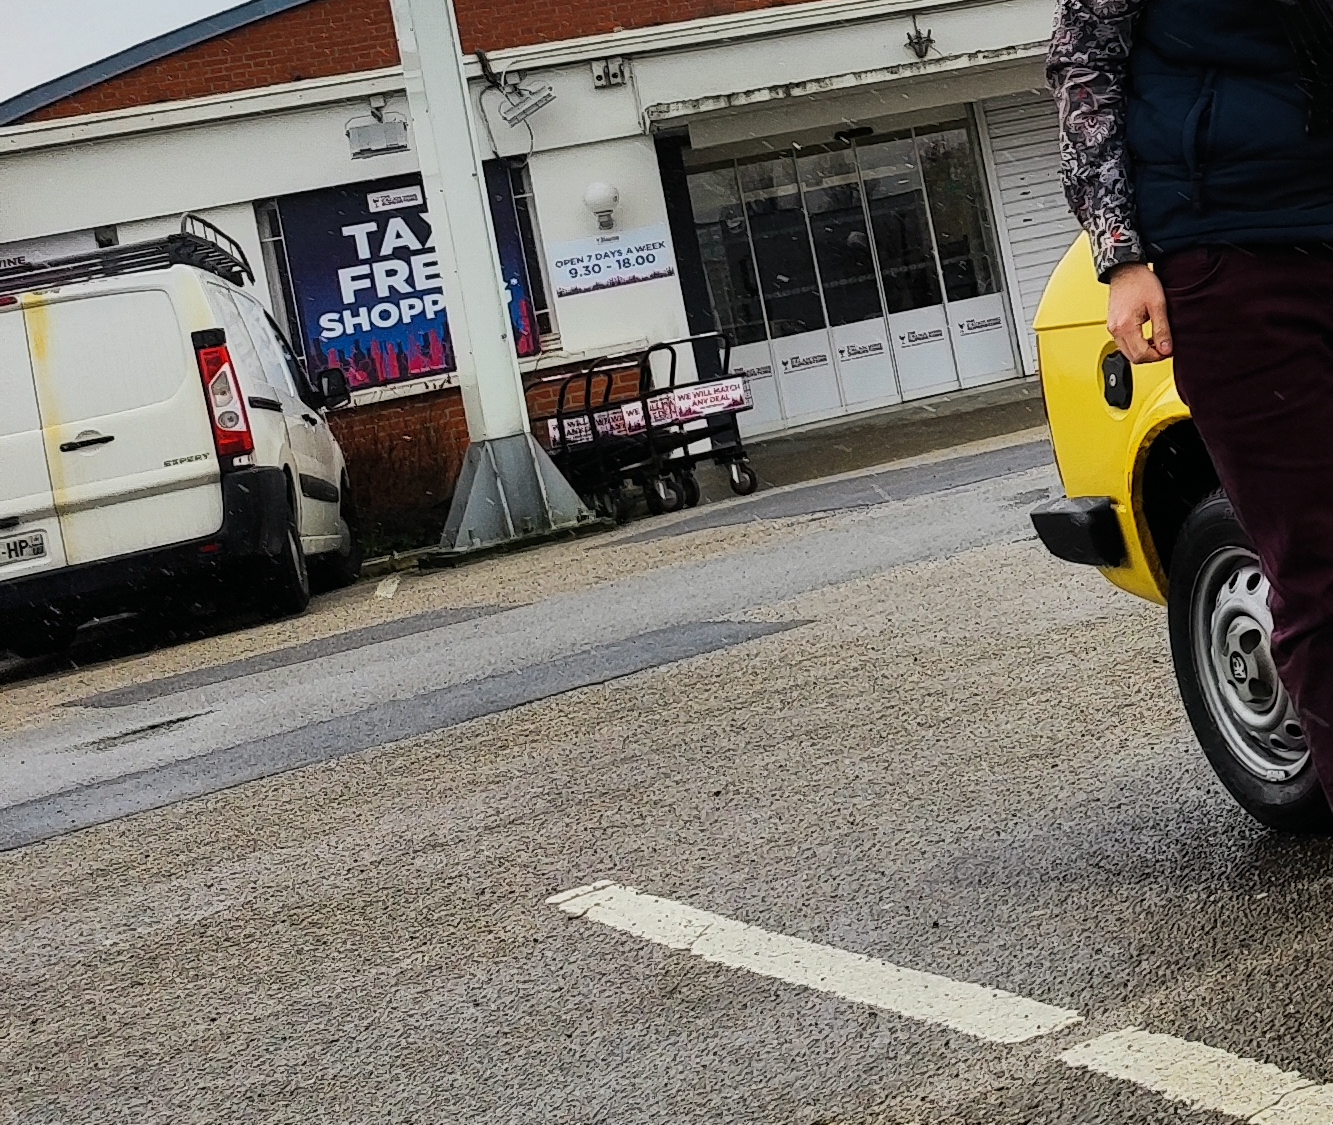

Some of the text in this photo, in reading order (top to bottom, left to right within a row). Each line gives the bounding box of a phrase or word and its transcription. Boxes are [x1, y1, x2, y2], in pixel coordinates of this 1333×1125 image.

[0, 255, 26, 268] INE
[555, 254, 584, 268] OPEN
[586, 254, 593, 263] 7
[594, 248, 623, 261] DAYS
[625, 246, 634, 256] A
[634, 240, 666, 252] WEEK
[568, 263, 602, 279] 9.30
[615, 253, 656, 270] 18.00
[337, 251, 443, 305] FRE
[318, 293, 448, 339] SHOPP
